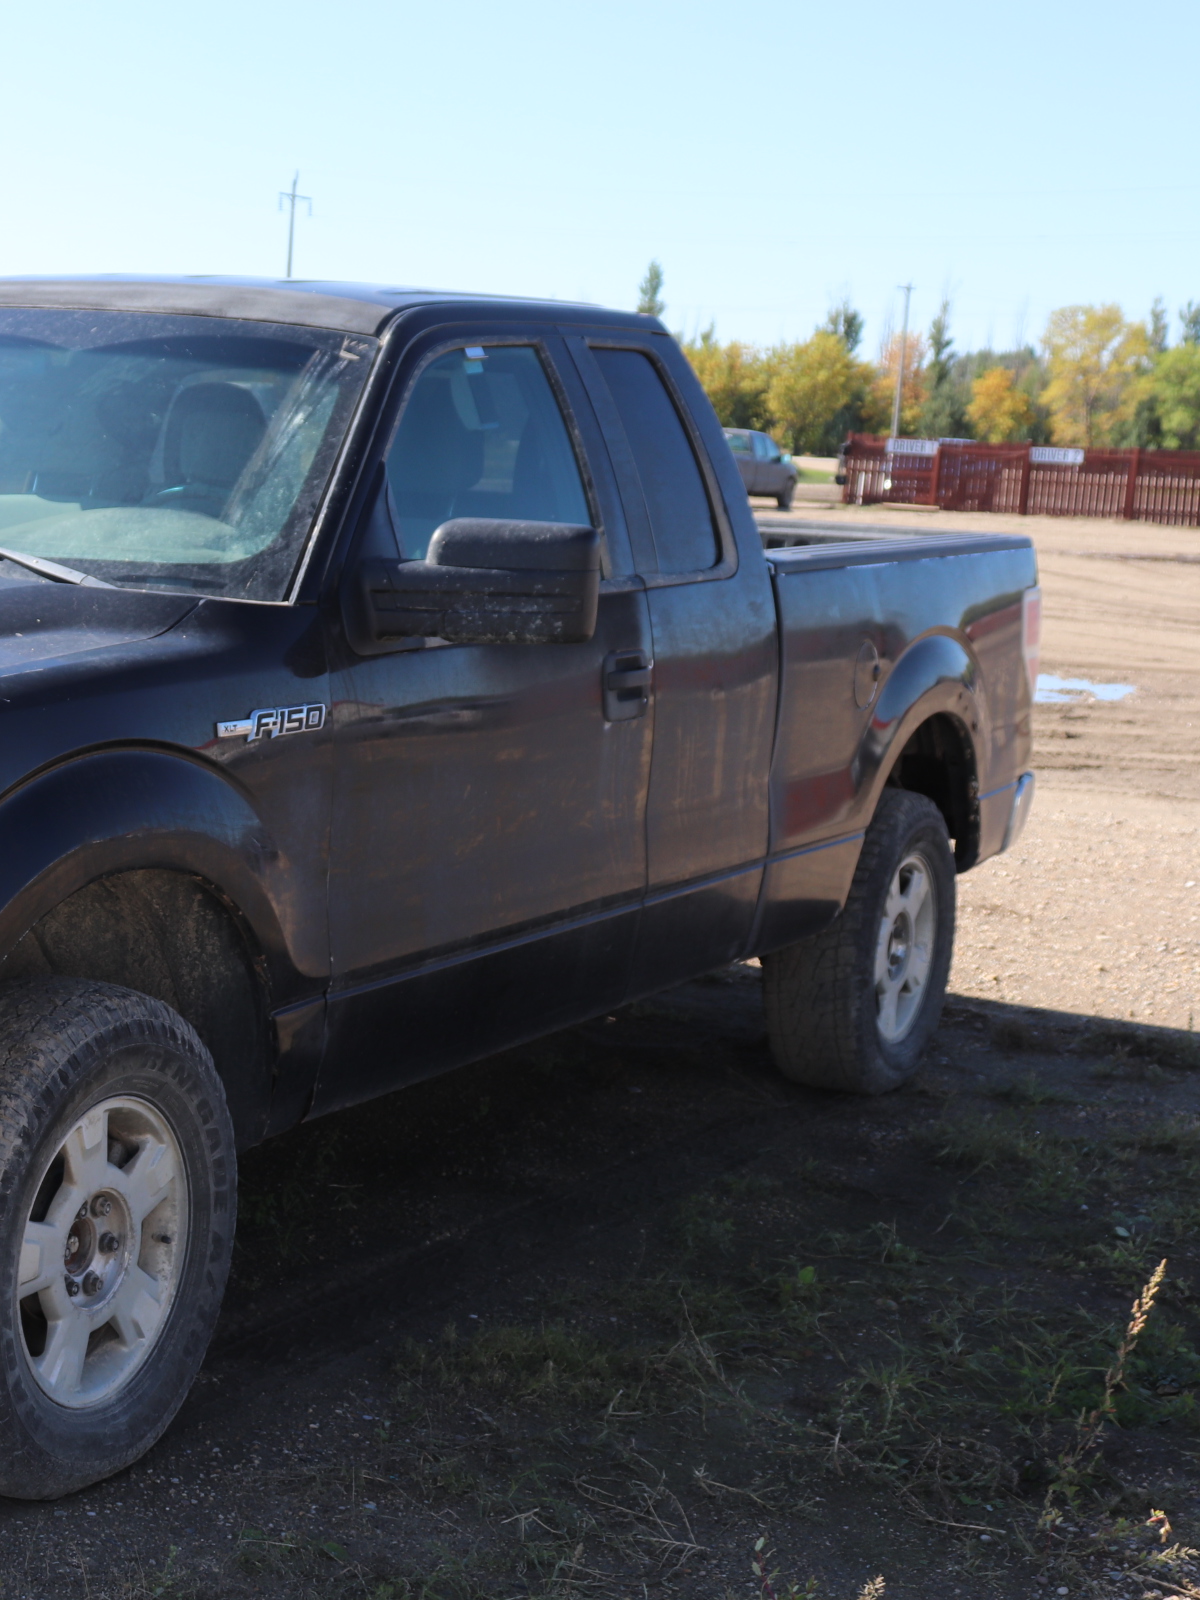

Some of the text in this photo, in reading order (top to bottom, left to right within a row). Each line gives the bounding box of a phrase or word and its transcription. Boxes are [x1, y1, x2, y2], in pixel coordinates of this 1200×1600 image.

[893, 439, 927, 453] DRIVER
[1034, 448, 1070, 461] DRIVER
[224, 724, 238, 733] XLT
